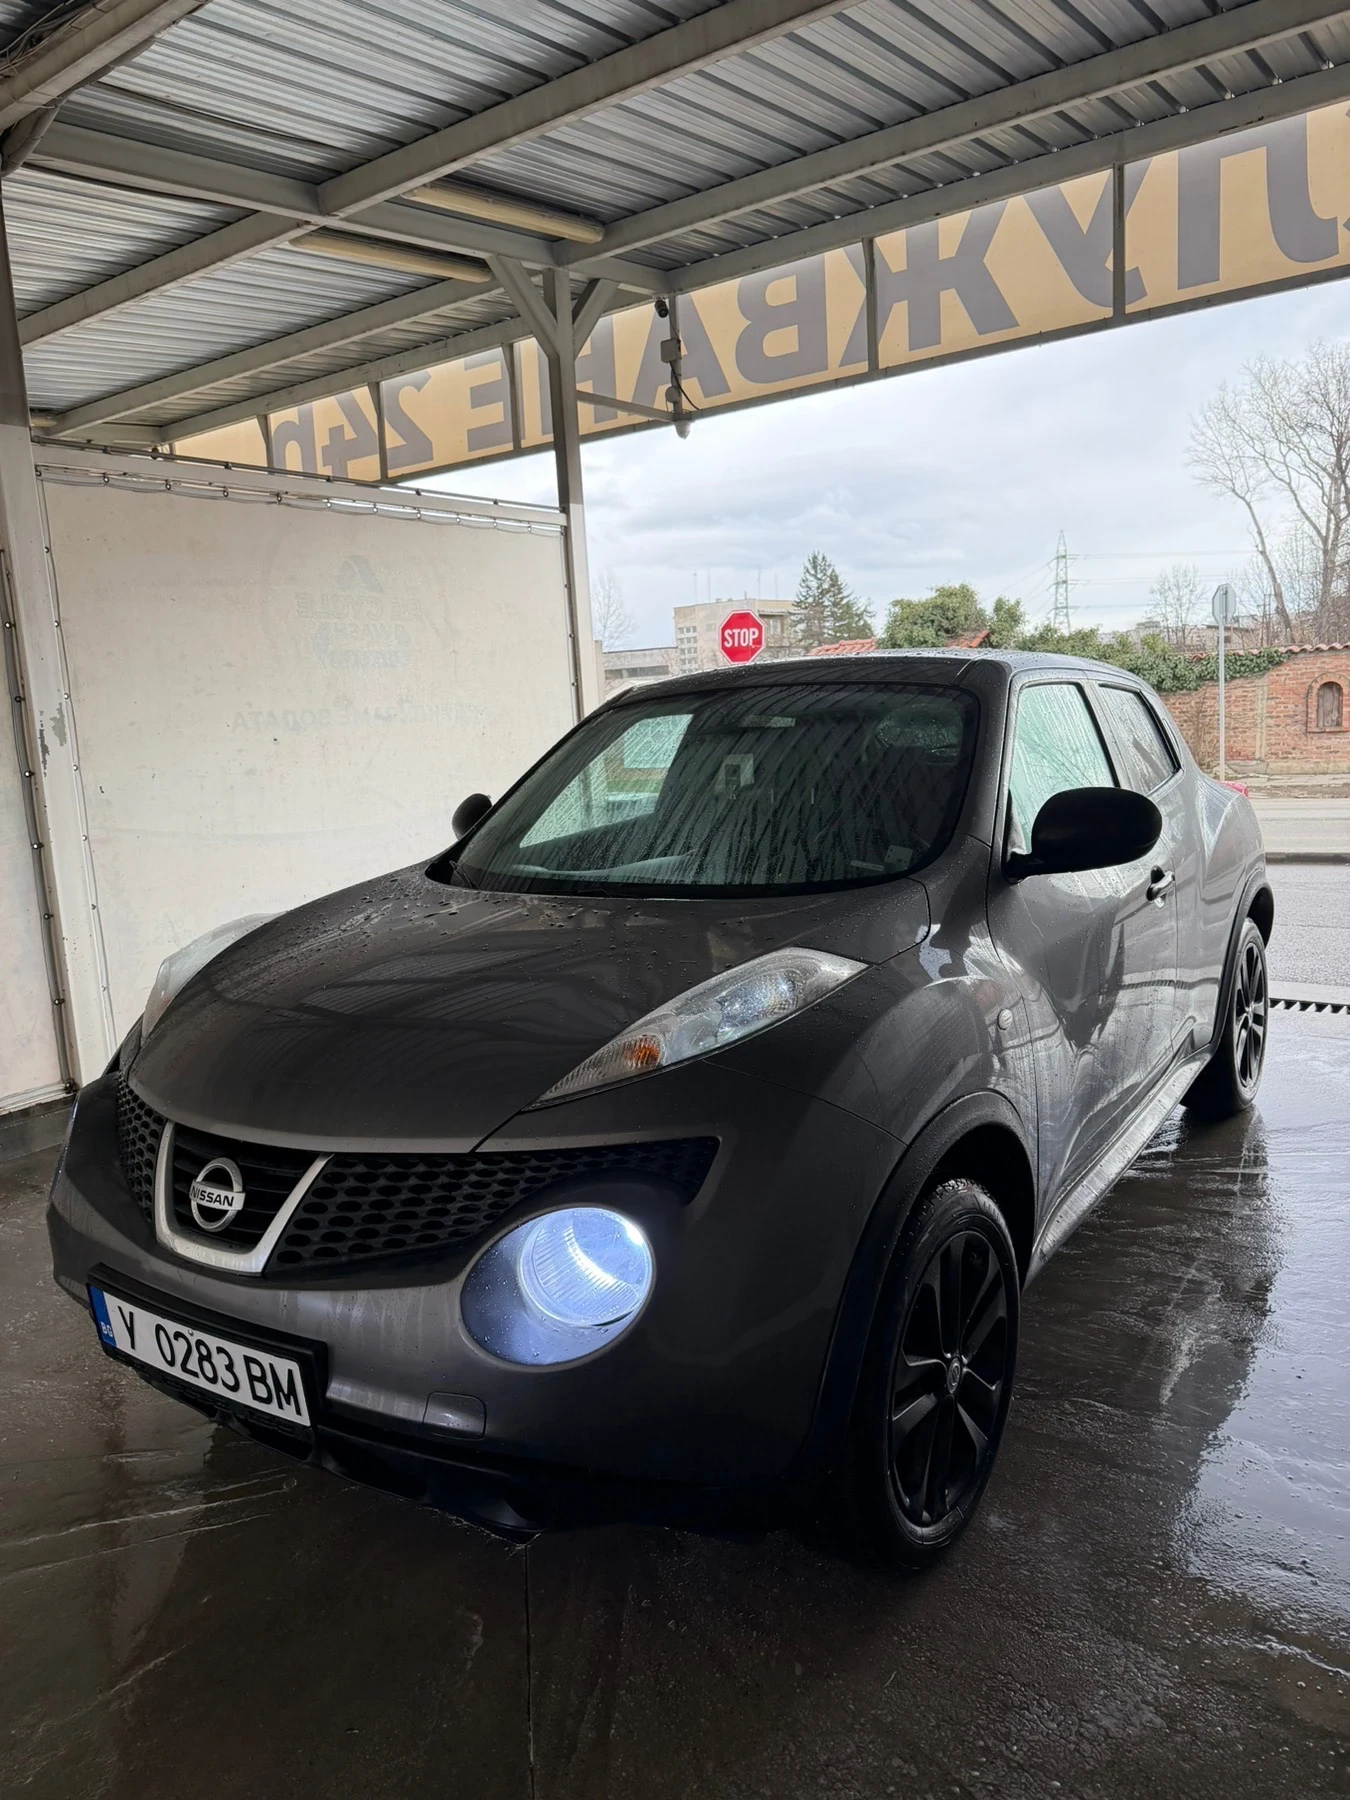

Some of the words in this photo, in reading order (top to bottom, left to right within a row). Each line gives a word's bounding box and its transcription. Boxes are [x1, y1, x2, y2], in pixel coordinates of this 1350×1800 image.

[724, 628, 759, 648] STOP
[191, 1186, 234, 1207] NISSAN
[100, 1321, 114, 1337] BG
[154, 1323, 240, 1393] 0283
[243, 1353, 302, 1417] BM
